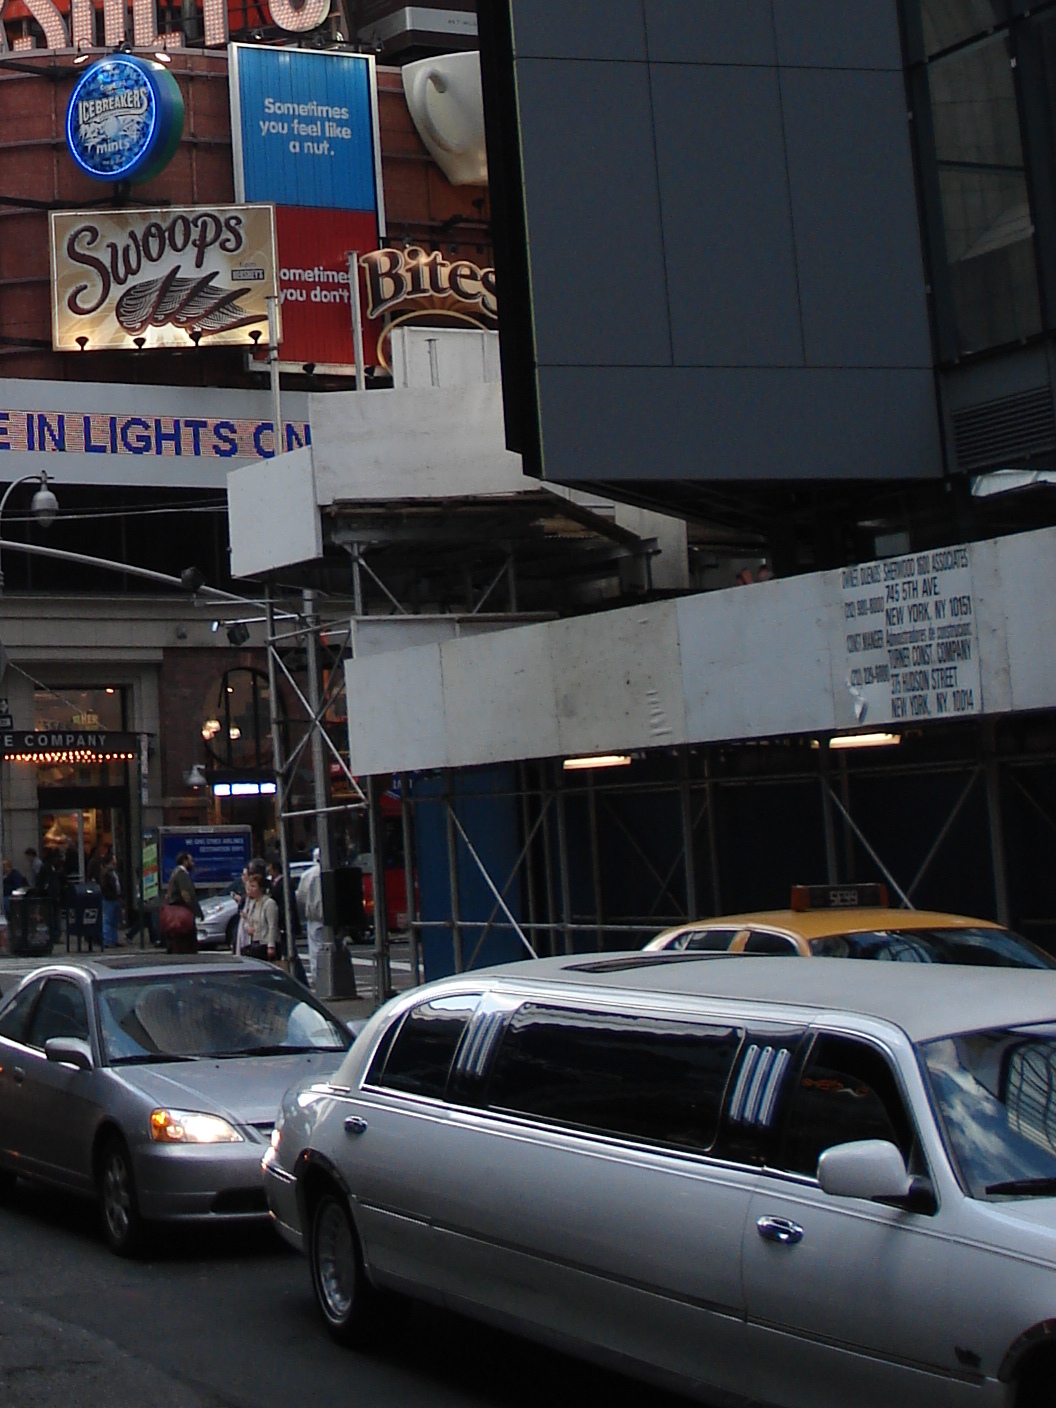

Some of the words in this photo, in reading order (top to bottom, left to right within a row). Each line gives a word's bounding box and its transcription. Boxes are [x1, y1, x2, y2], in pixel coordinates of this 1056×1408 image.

[264, 98, 350, 120] Sometimes
[259, 121, 288, 136] you
[291, 119, 322, 137] feel
[325, 122, 352, 139] like
[289, 142, 300, 153] a
[304, 141, 335, 156] nut.
[27, 411, 66, 453] IN
[82, 413, 239, 457] LIGHTS
[885, 583, 900, 603] 745
[901, 579, 918, 601] 5TH
[885, 606, 904, 626] NEW
[934, 599, 946, 620] NY
[937, 638, 971, 664] COMPANY
[902, 669, 930, 692] HUDSON
[931, 666, 957, 690] STREET
[892, 696, 907, 718] NEW
[24, 734, 108, 749] COMPANY
